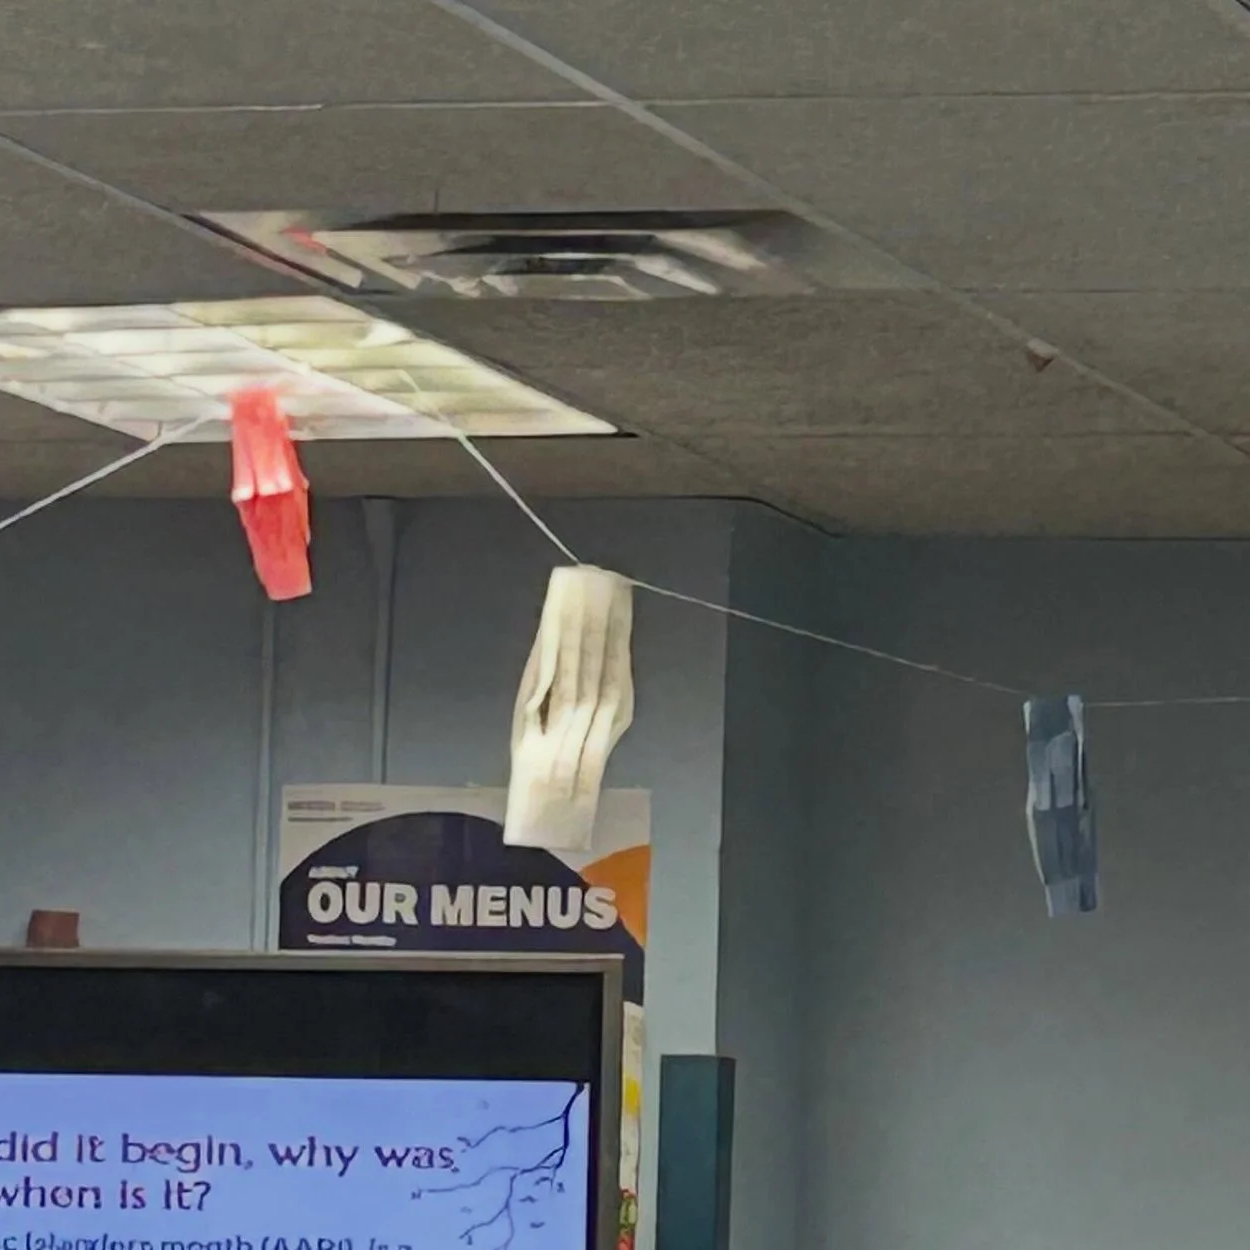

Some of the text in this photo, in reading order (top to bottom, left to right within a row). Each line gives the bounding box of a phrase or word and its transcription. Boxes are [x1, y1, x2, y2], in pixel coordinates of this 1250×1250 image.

[308, 881, 618, 930] OUR MENUS
[77, 1134, 105, 1164] it
[122, 1134, 254, 1173] begin,
[269, 1136, 358, 1177] why
[120, 1180, 145, 1210] is
[164, 1181, 211, 1211] it?
